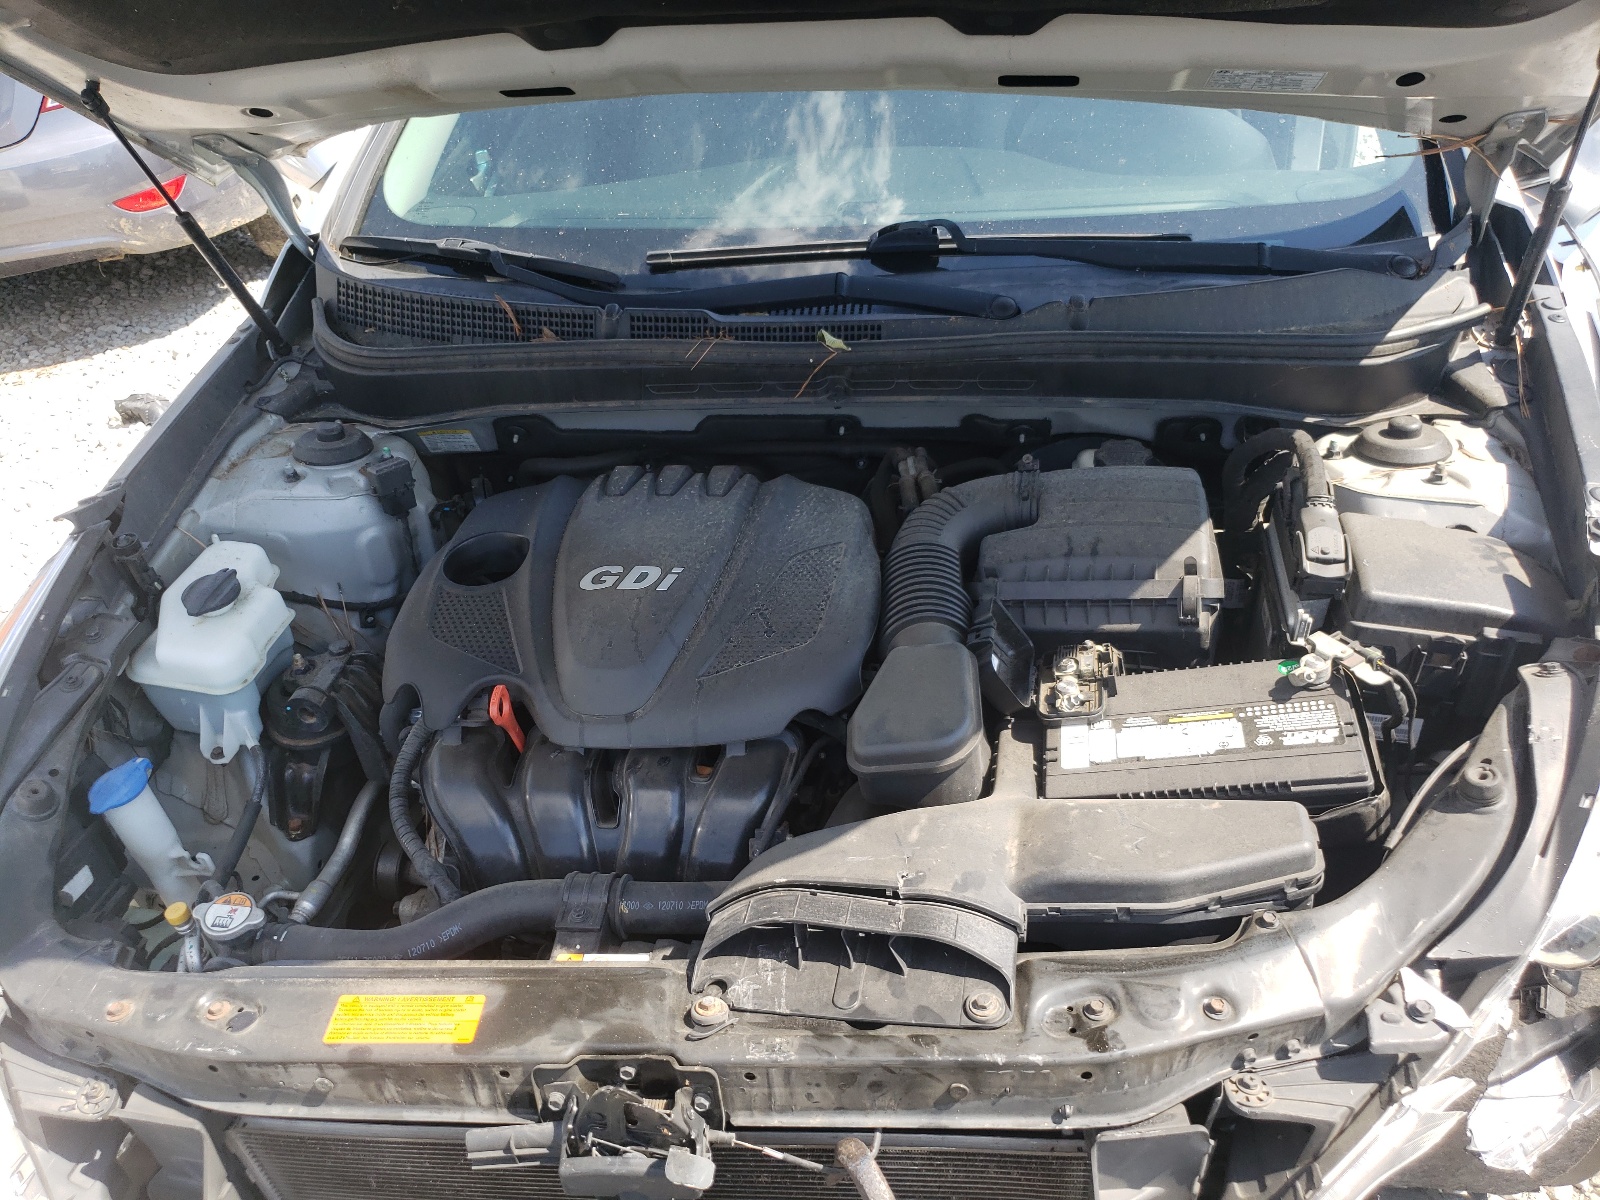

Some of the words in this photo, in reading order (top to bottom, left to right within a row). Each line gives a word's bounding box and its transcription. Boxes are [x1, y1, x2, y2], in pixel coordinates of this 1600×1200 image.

[579, 565, 685, 591] GDi
[658, 901, 684, 910] 120710
[407, 938, 436, 958] 120710
